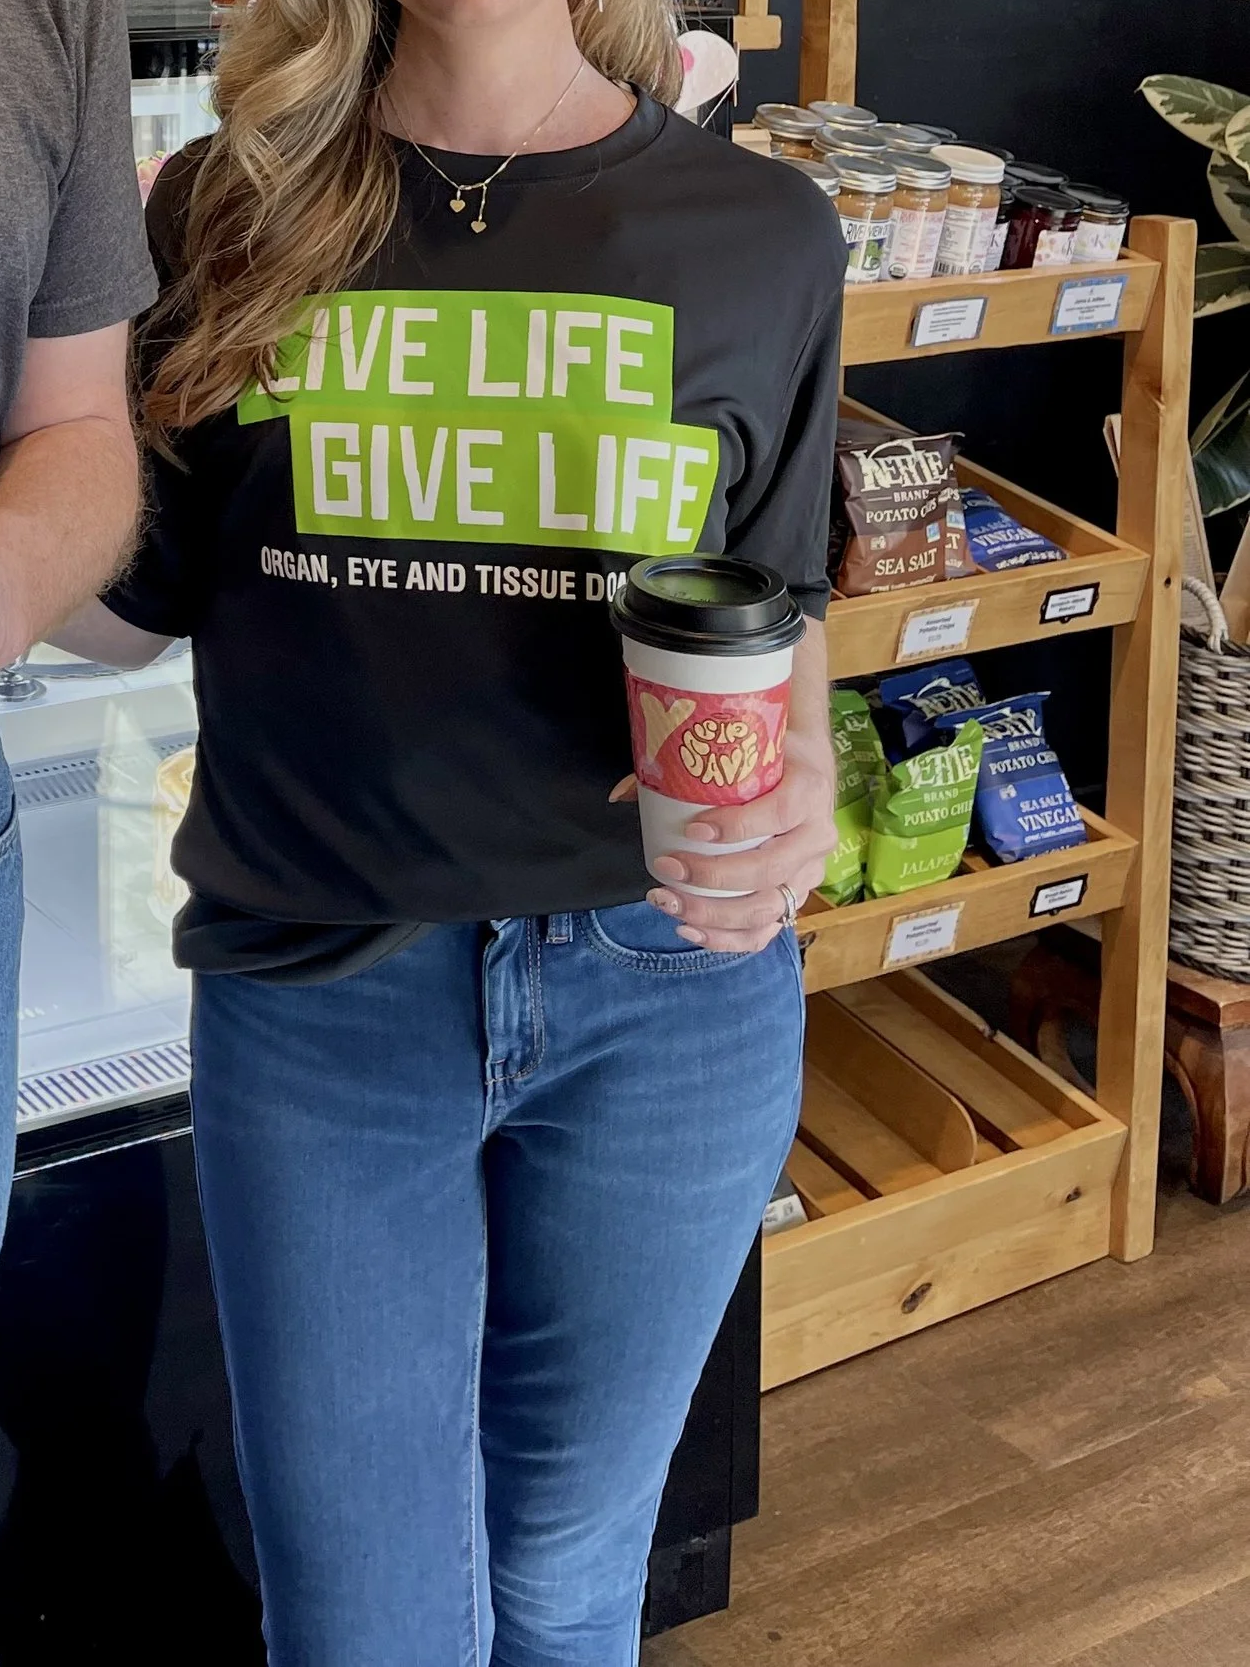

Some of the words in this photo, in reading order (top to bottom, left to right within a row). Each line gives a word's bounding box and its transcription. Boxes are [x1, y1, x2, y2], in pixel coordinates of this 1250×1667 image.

[467, 309, 654, 406] LIFE
[310, 421, 504, 526] GIVE
[538, 431, 709, 543] LIFE
[866, 506, 918, 524] POTATO
[260, 546, 338, 589] ORGAN,
[347, 557, 396, 589] EYE
[405, 562, 466, 593] AND
[476, 564, 577, 600] TISSUE
[875, 557, 906, 576] SEA
[908, 547, 938, 573] SALT
[679, 728, 759, 788] SAVE
[988, 754, 1036, 775] POTATO
[923, 787, 959, 804] BRAND
[1019, 797, 1040, 813] SEA
[1038, 793, 1064, 809] SALT
[904, 805, 949, 827] POTATO
